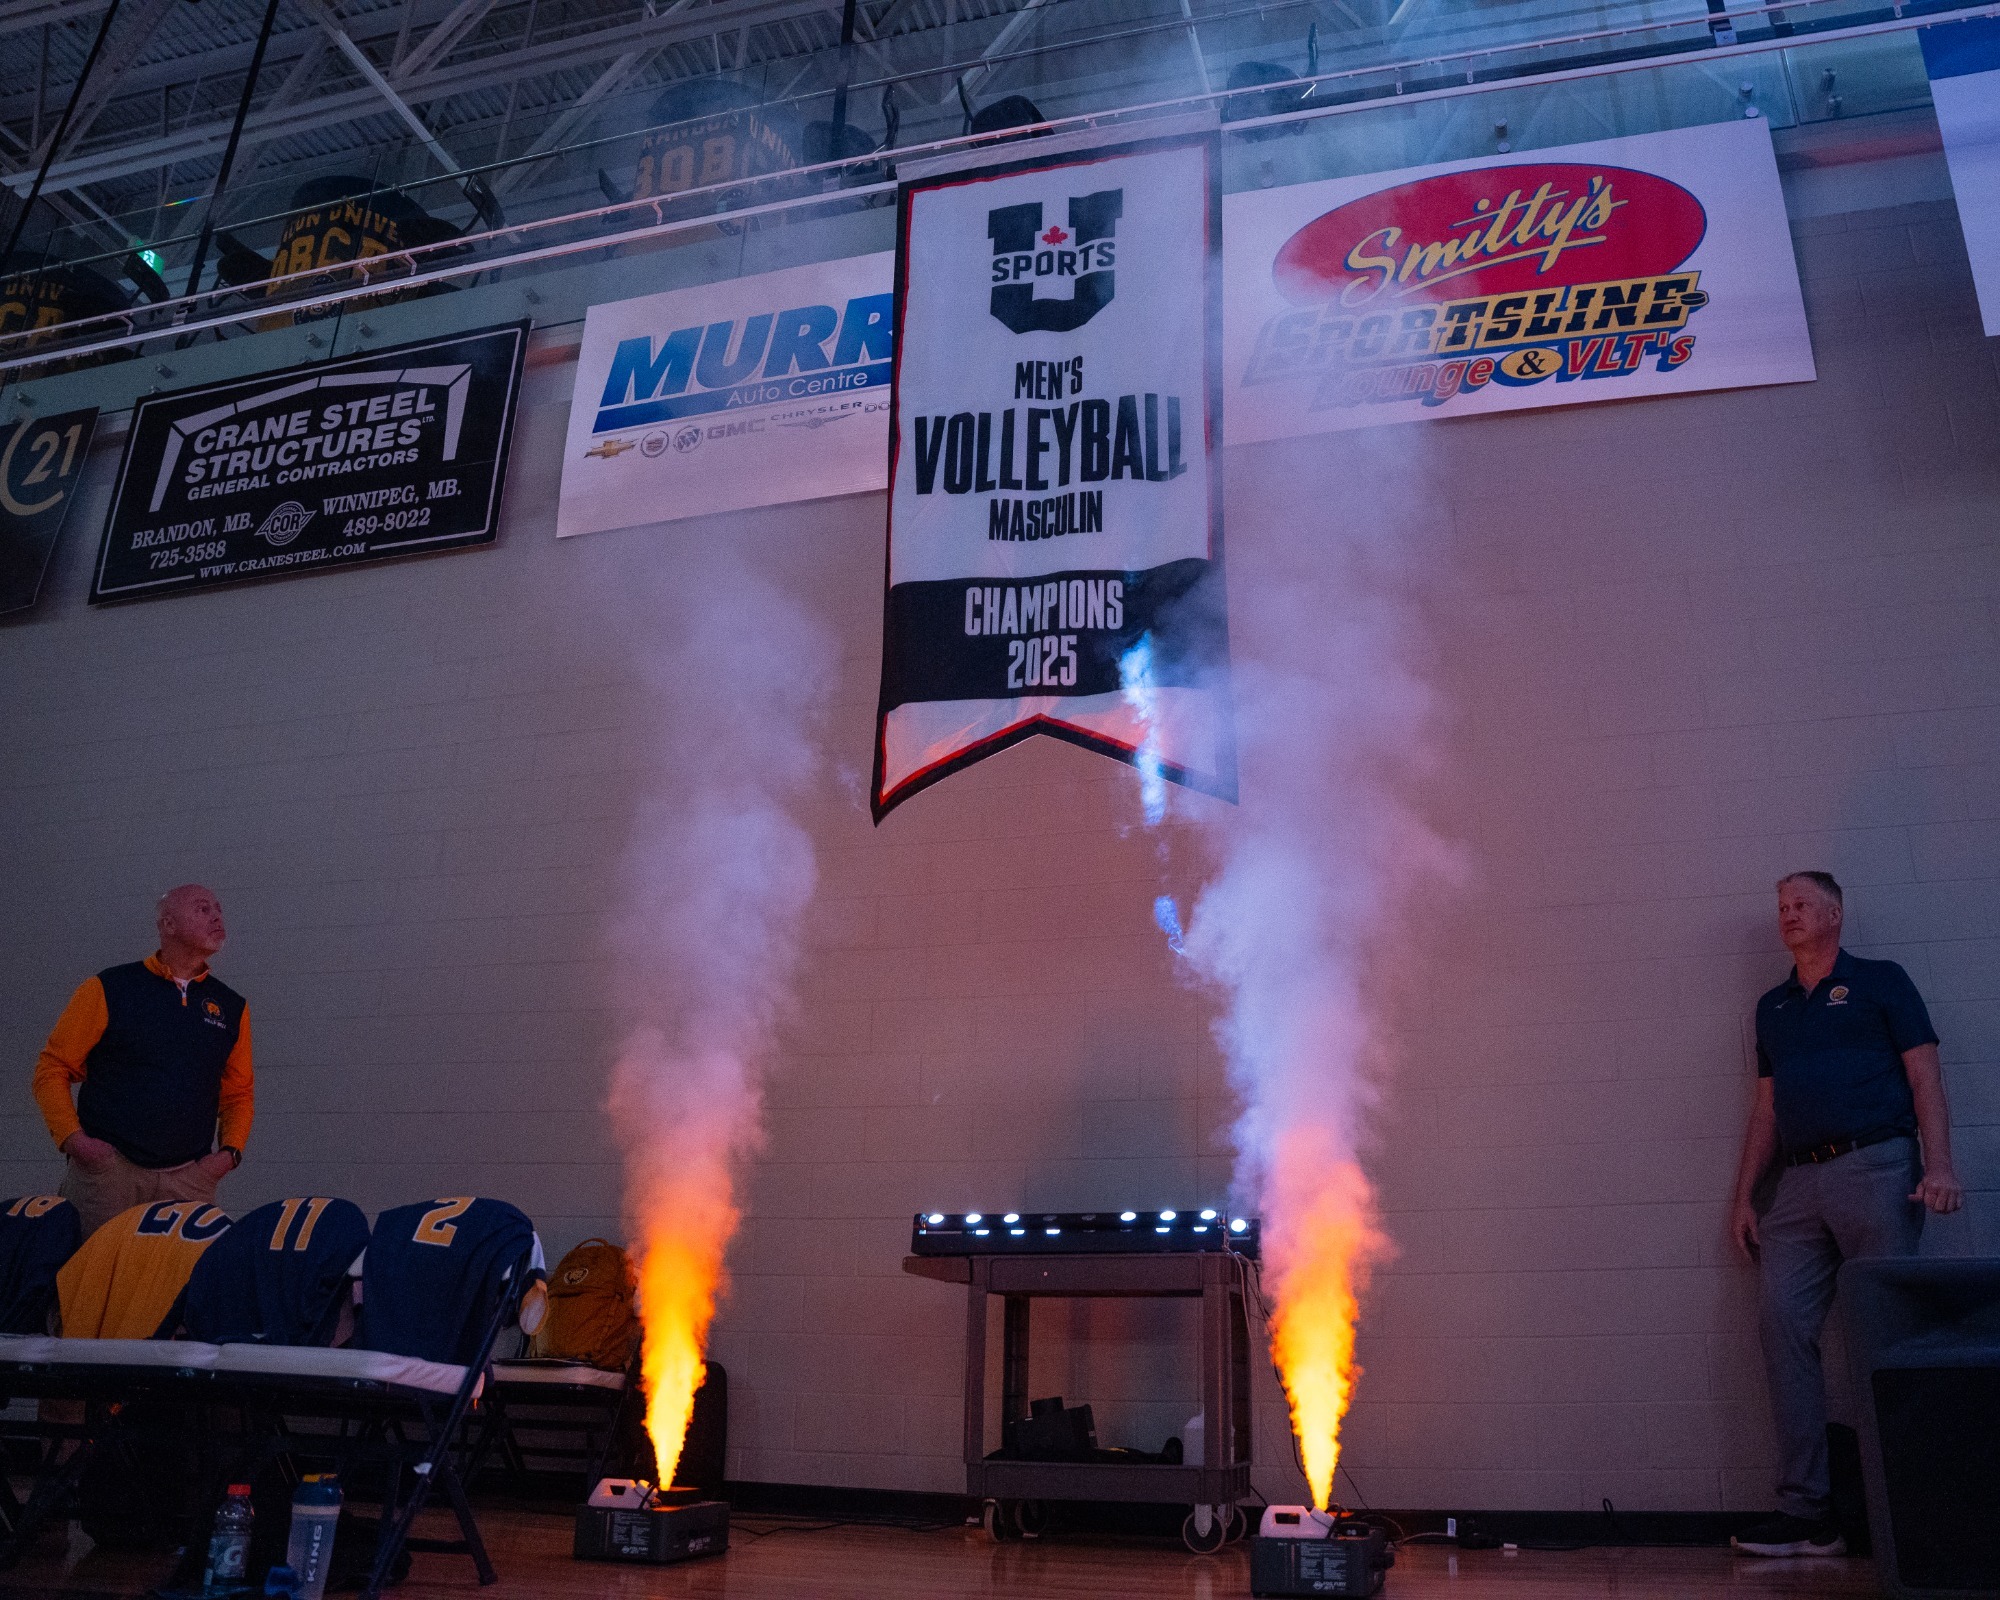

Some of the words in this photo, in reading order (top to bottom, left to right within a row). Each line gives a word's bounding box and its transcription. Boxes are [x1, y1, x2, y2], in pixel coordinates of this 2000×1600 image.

[990, 241, 1116, 283] SPORTS
[1338, 175, 1629, 306] Smitty's
[1516, 350, 1547, 376] &
[1568, 334, 1693, 375] VLT's
[726, 385, 781, 407] Auto
[788, 370, 868, 397] Centre
[1014, 355, 1084, 401] MEN'S
[194, 409, 313, 454] CRANE
[320, 388, 437, 431] STEEL
[707, 418, 767, 440] GMC
[770, 401, 863, 422] CHRYSLER
[184, 418, 422, 484] STRUCTURES
[914, 392, 1188, 496] VOLLEYBALL
[187, 474, 271, 501] GENERAL
[276, 448, 419, 484] CONTRACTORS
[322, 484, 420, 516] WINNIPEG,
[426, 478, 463, 500] MB.
[988, 490, 1104, 542] MASCULIN
[131, 518, 217, 550] BRANDON,
[223, 512, 254, 534] MB.
[270, 513, 301, 533] COR
[342, 507, 431, 537] 489-8022
[149, 540, 227, 570] 725-3588
[200, 542, 366, 579] WWW.CRANESTEEL.COM
[965, 579, 1124, 636] CHAMPIONS
[1007, 634, 1078, 690] 2025
[269, 1197, 335, 1251] 11
[412, 1196, 477, 1247] 2
